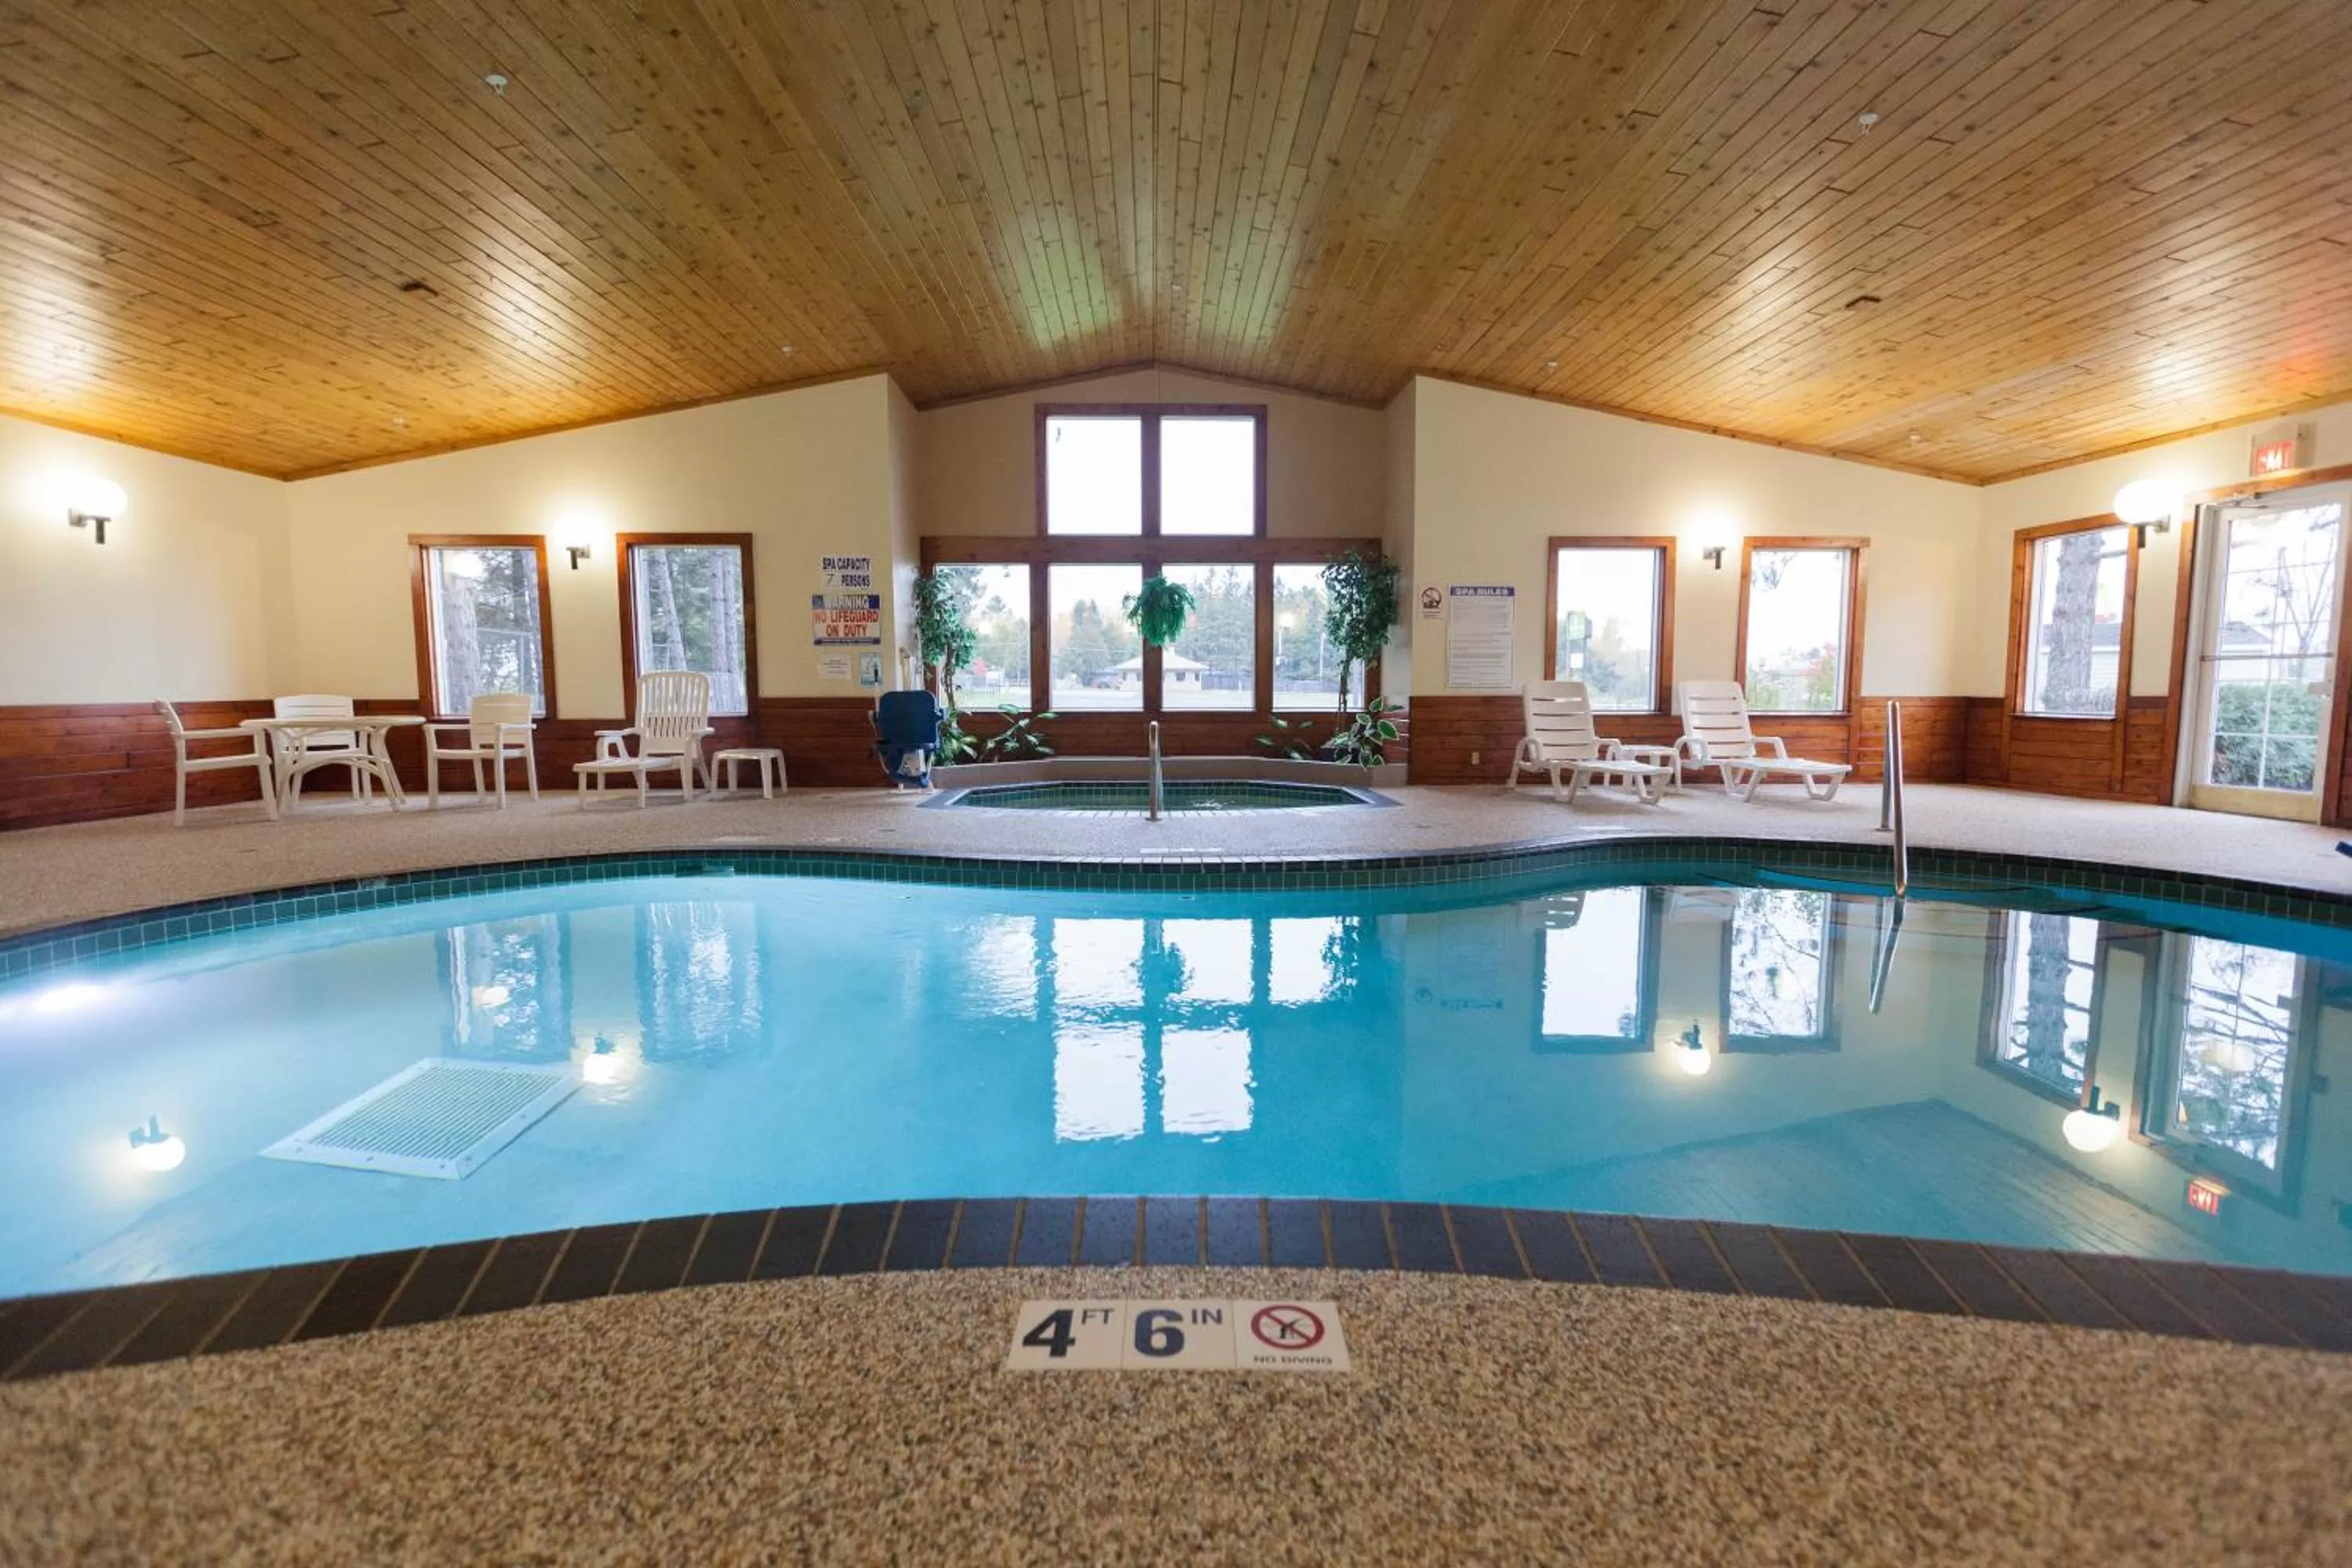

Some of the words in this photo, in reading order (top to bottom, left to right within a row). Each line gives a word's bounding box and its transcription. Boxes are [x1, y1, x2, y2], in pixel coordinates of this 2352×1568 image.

[822, 557, 836, 570] SPA
[837, 557, 870, 571] CAPACITY
[827, 574, 835, 585] 7
[841, 574, 870, 586] PERSONS
[1454, 587, 1474, 596] SPA
[1477, 587, 1508, 596] RULES
[823, 595, 869, 609] WARNING
[815, 612, 826, 623] NO
[831, 611, 878, 623] LIFEGUARD
[826, 624, 839, 637] ON
[844, 624, 868, 637] DUTY
[1022, 1308, 1076, 1358] 4
[1081, 1308, 1114, 1325] FT
[1134, 1308, 1185, 1357] 6
[1192, 1308, 1223, 1325] IN
[1254, 1355, 1276, 1363] NO
[1280, 1355, 1333, 1364] DIVING
